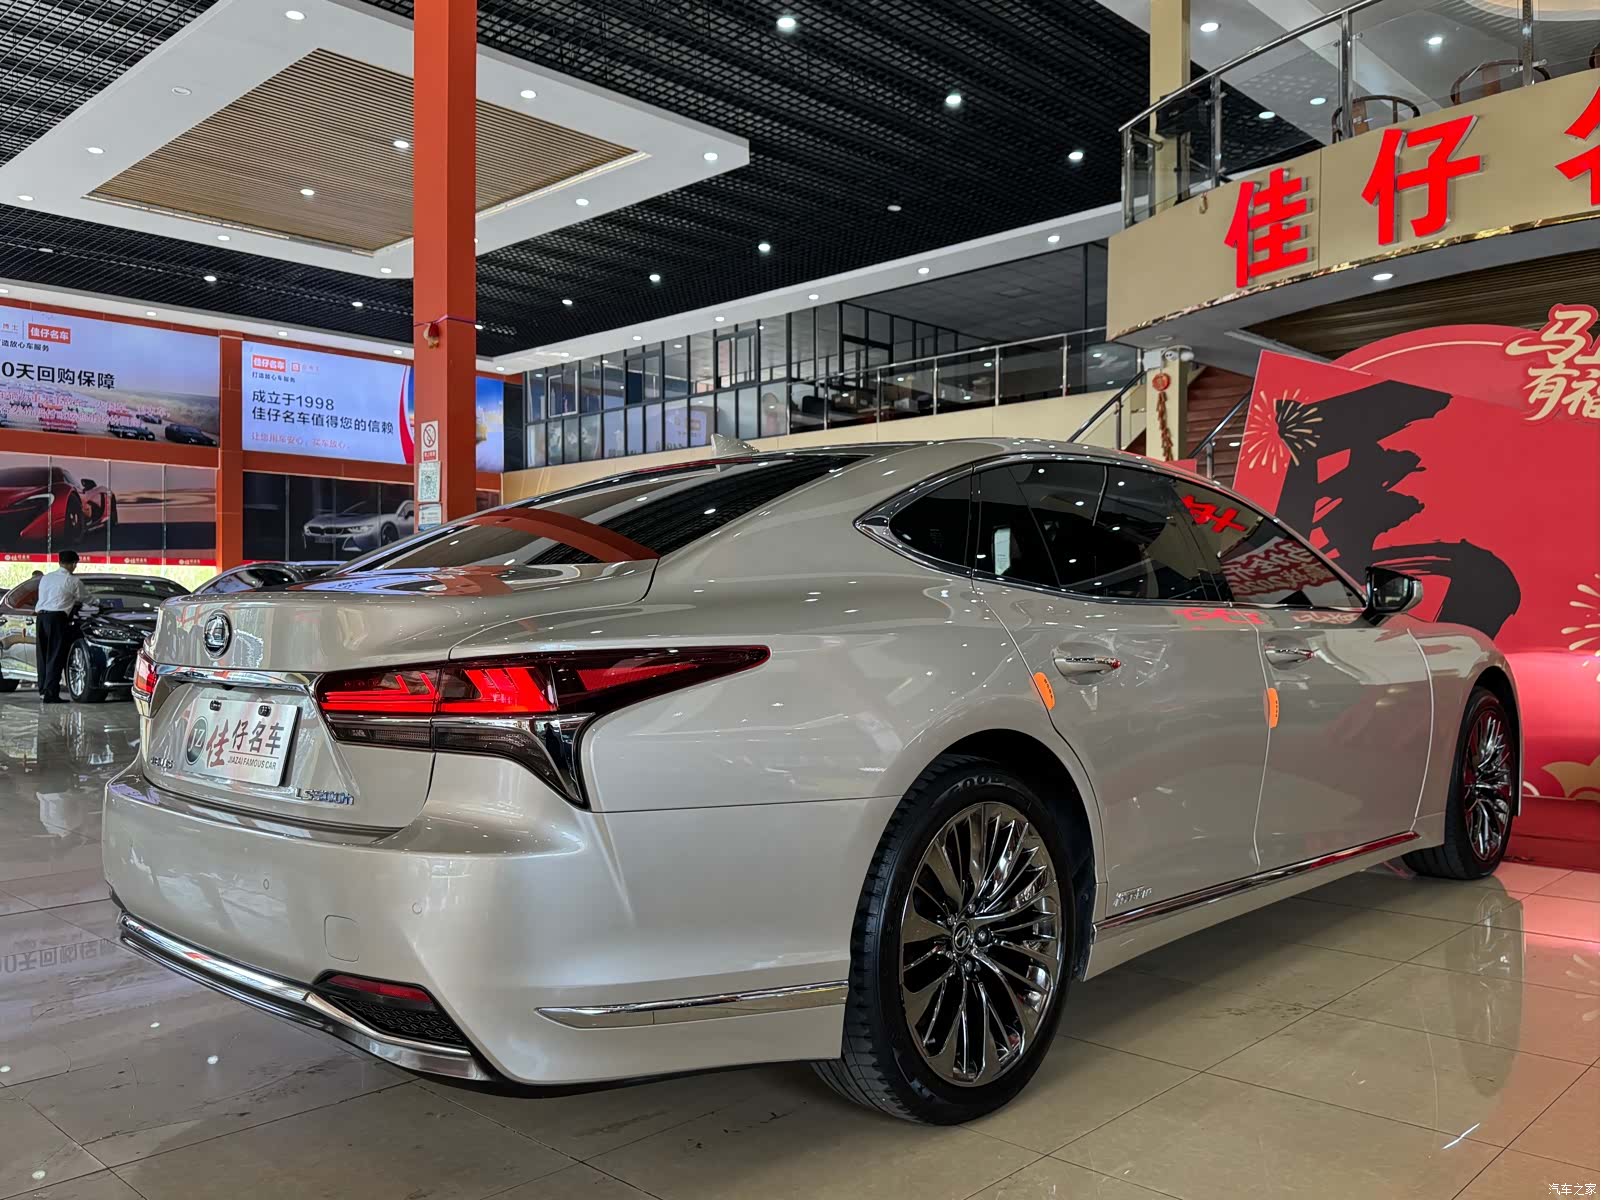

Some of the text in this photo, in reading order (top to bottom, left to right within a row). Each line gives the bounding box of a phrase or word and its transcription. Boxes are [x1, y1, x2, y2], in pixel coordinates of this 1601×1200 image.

[30, 326, 69, 341] 佳仔名车
[252, 389, 335, 411] 成立于1998
[252, 406, 394, 435] 佳仔名车值得您的信赖
[188, 728, 206, 752] JZ
[206, 719, 285, 768] 佳仔名车
[243, 757, 265, 768] FAMOUS
[265, 761, 277, 770] CAR
